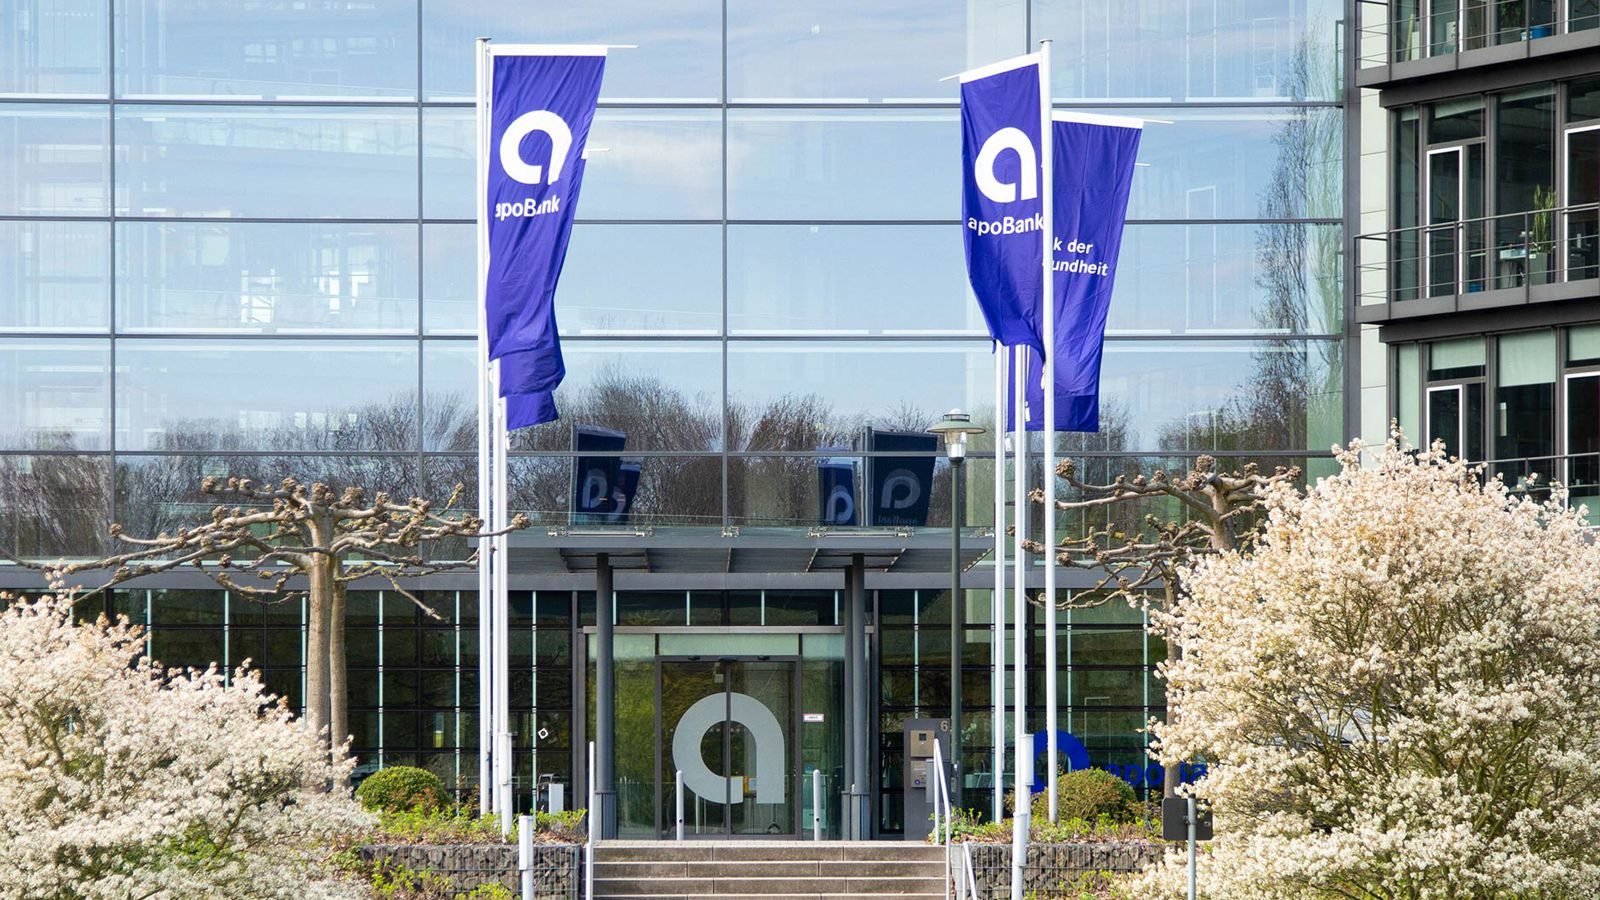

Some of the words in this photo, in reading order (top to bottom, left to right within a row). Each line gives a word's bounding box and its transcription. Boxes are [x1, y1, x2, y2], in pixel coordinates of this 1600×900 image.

[968, 212, 1044, 236] apoBank
[1067, 239, 1093, 254] der
[1052, 260, 1108, 276] undheit
[941, 720, 949, 732] 6
